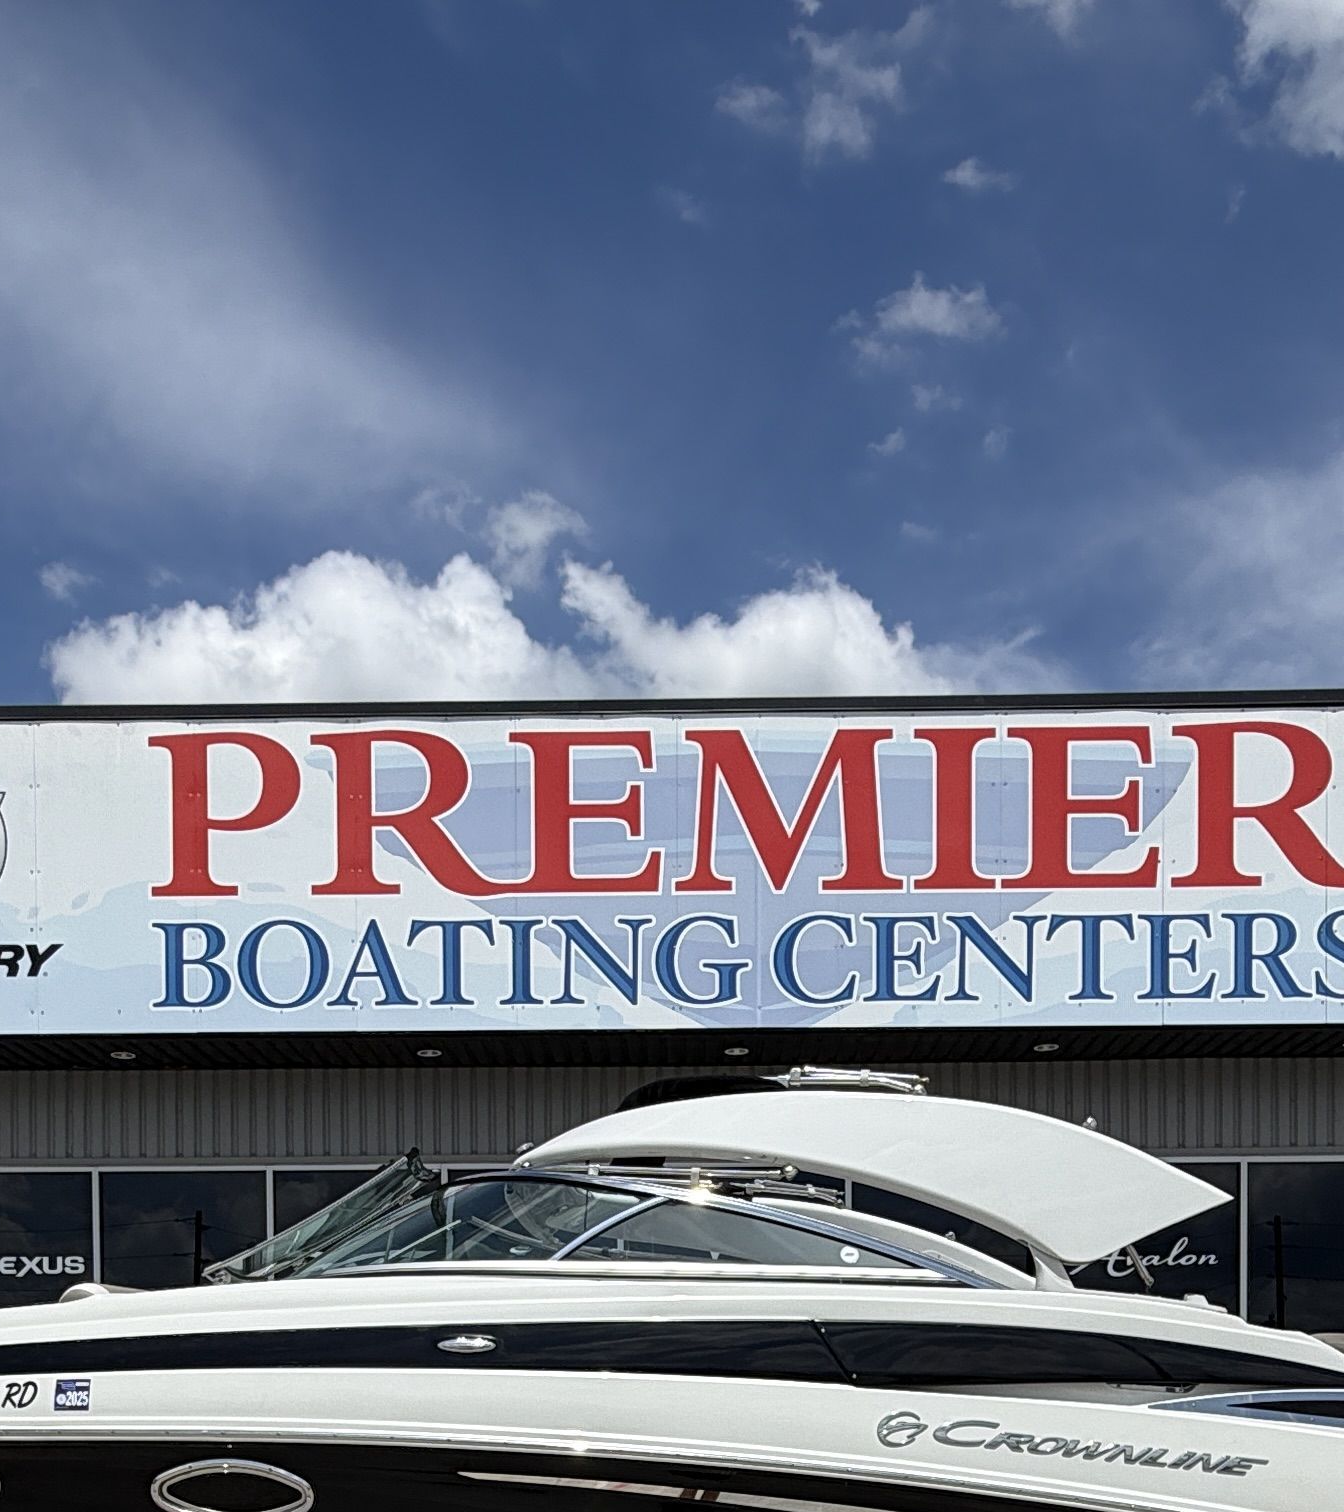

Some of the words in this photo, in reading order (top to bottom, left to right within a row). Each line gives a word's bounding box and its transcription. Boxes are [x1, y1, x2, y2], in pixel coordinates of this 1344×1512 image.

[151, 917, 750, 1010] BOATING
[1, 1381, 38, 1409] RD
[65, 1390, 89, 1407] 2025
[932, 1418, 1269, 1479] CROWNLINE
